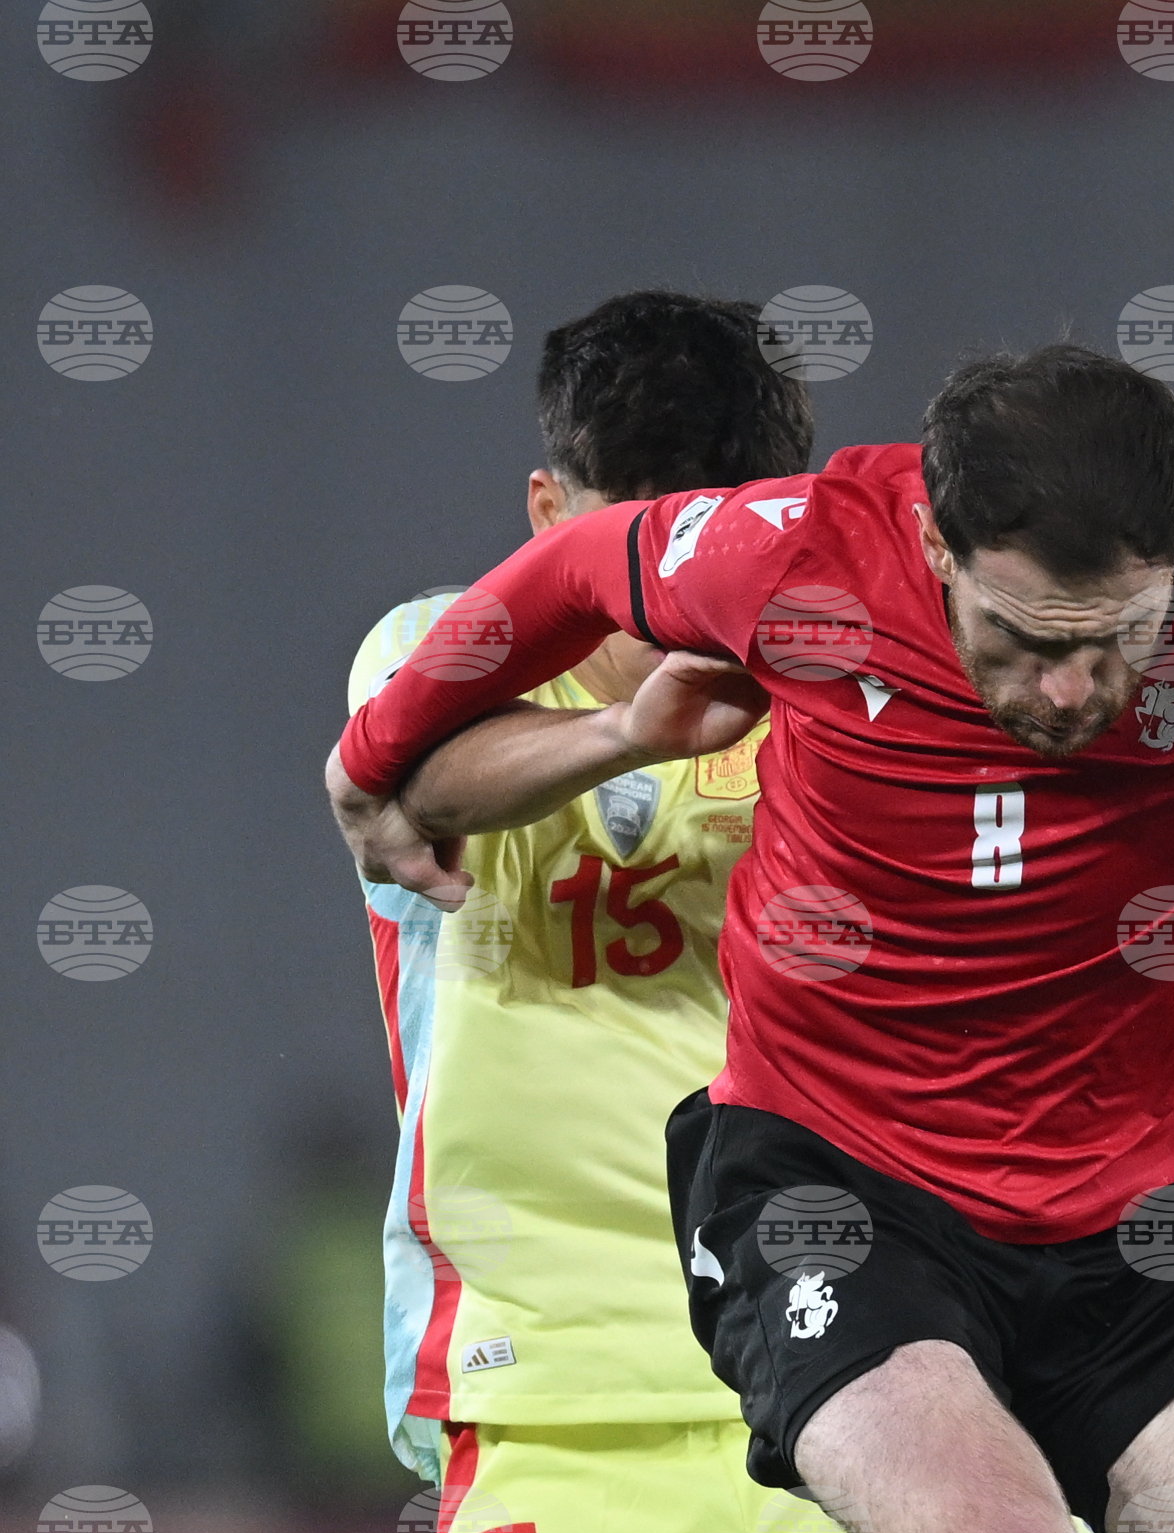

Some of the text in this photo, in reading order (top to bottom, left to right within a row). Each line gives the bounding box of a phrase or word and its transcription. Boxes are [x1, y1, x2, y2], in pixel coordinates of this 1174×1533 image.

[708, 814, 743, 824] GEORGIA
[712, 823, 754, 834] NOVEMBE
[971, 781, 1026, 891] 8
[550, 853, 684, 989] 15
